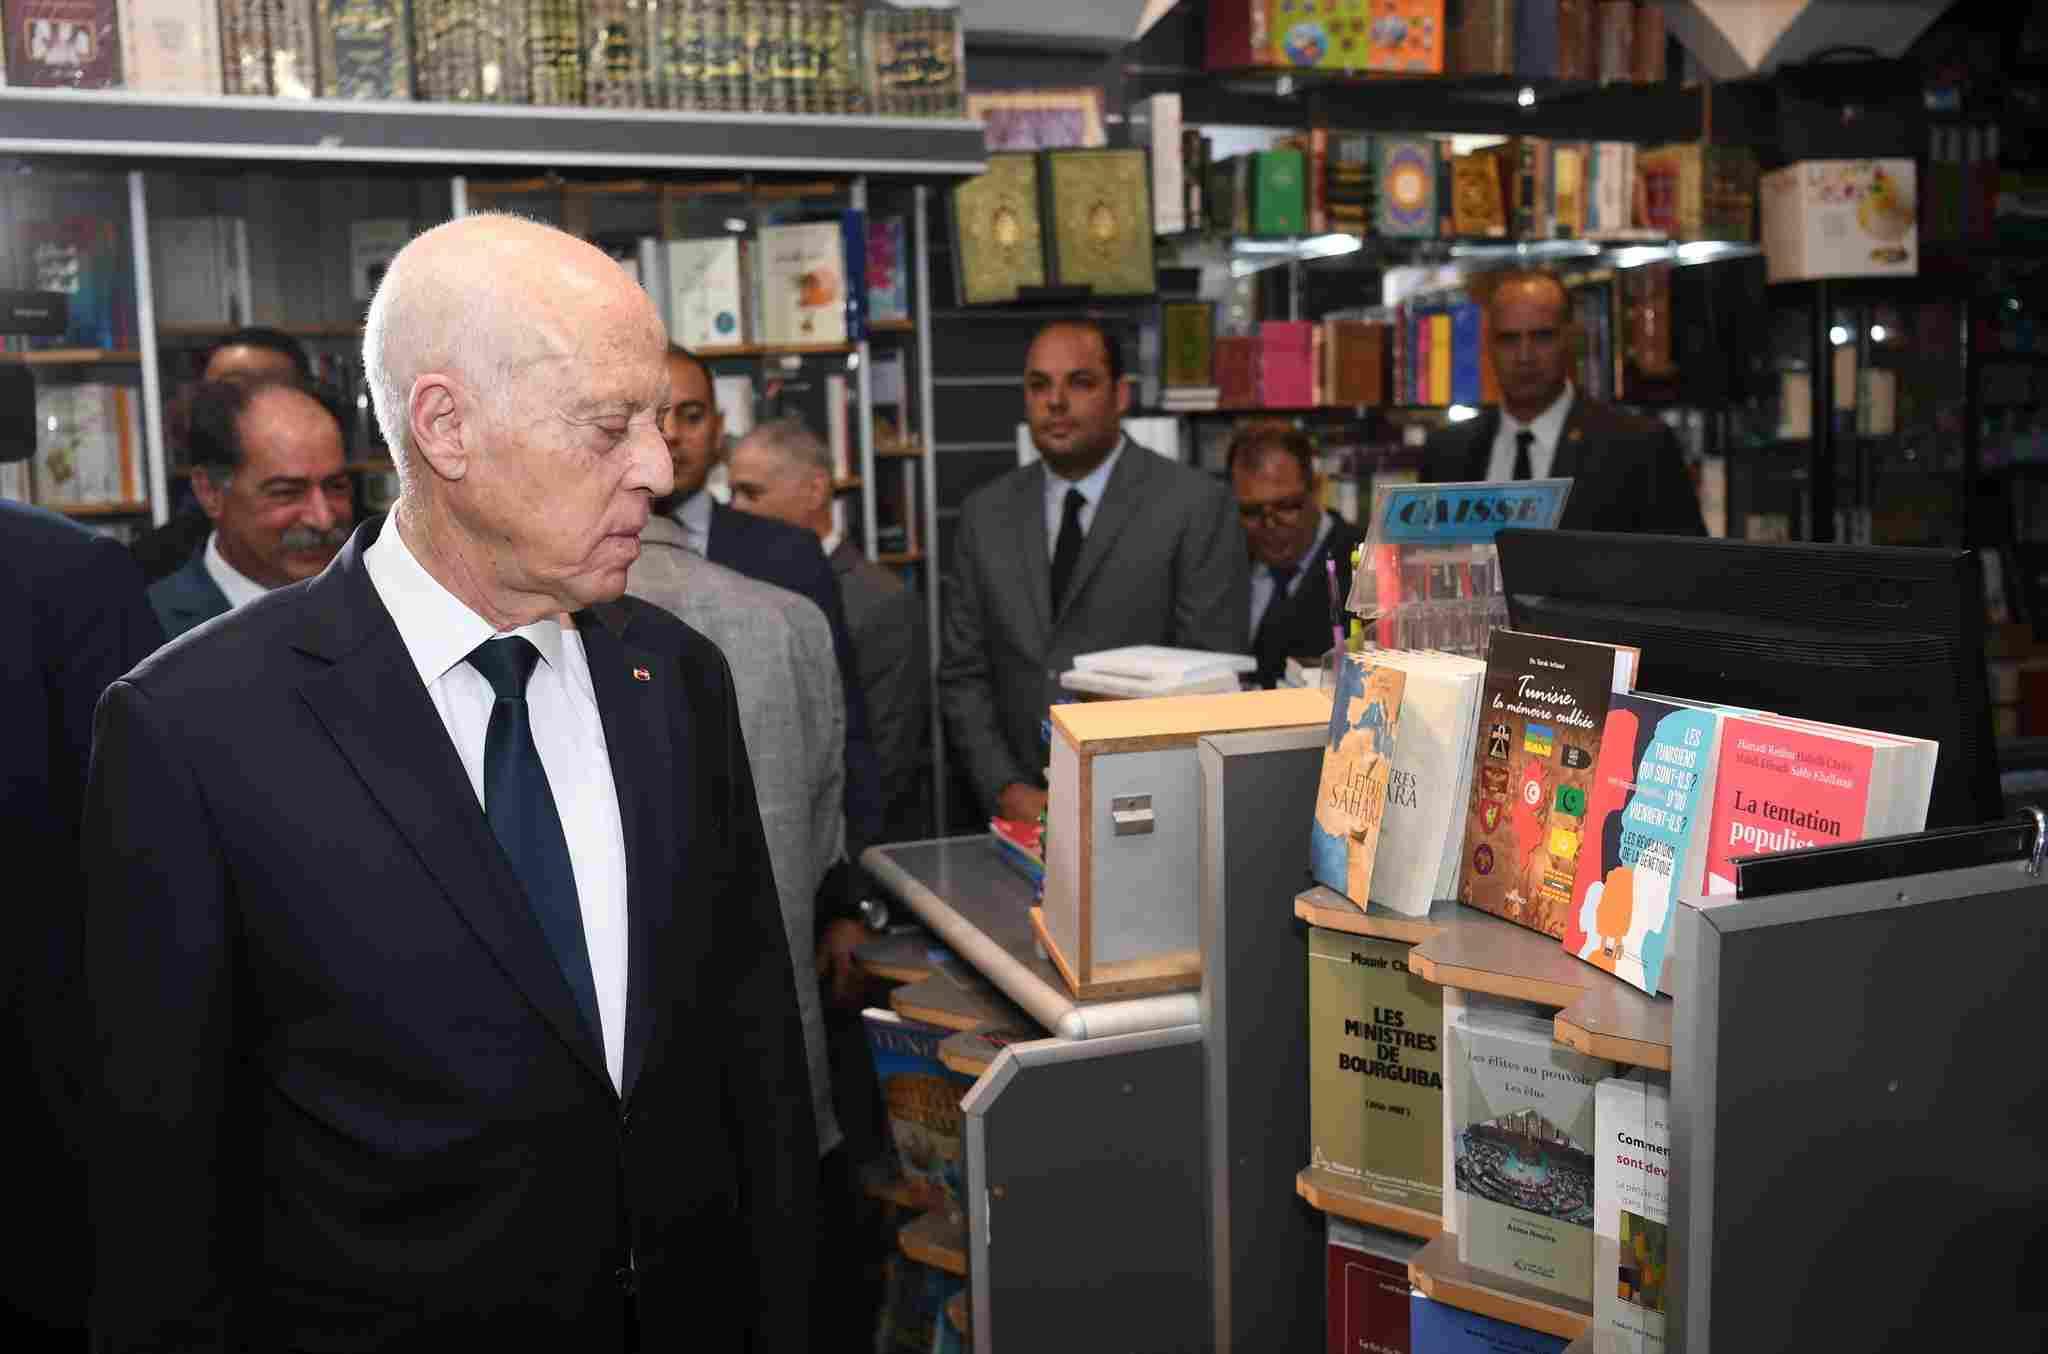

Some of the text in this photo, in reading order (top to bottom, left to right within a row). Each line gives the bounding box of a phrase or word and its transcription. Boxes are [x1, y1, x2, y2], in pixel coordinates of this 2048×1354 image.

[1398, 495, 1542, 524] CAISSE
[1518, 675, 1577, 705] Tunisie,
[1492, 693, 1596, 729] la mémoire oubliée
[1684, 728, 1703, 747] LES
[1655, 742, 1697, 768] TUNISIENS
[1640, 760, 1655, 781] QUI
[1735, 790, 1841, 837] La tentation
[1623, 832, 1636, 847] LES
[1729, 820, 1816, 853] populist
[1374, 1007, 1404, 1028] LES
[1345, 1019, 1437, 1051] MINISTRES
[1377, 1045, 1400, 1063] DE
[1467, 1050, 1485, 1063] Les
[1487, 1055, 1520, 1071] élites
[1522, 1066, 1538, 1075] au
[1339, 1053, 1443, 1090] BOURGUIBA
[1504, 1081, 1522, 1095] Les
[1616, 1154, 1671, 1178] sont dev
